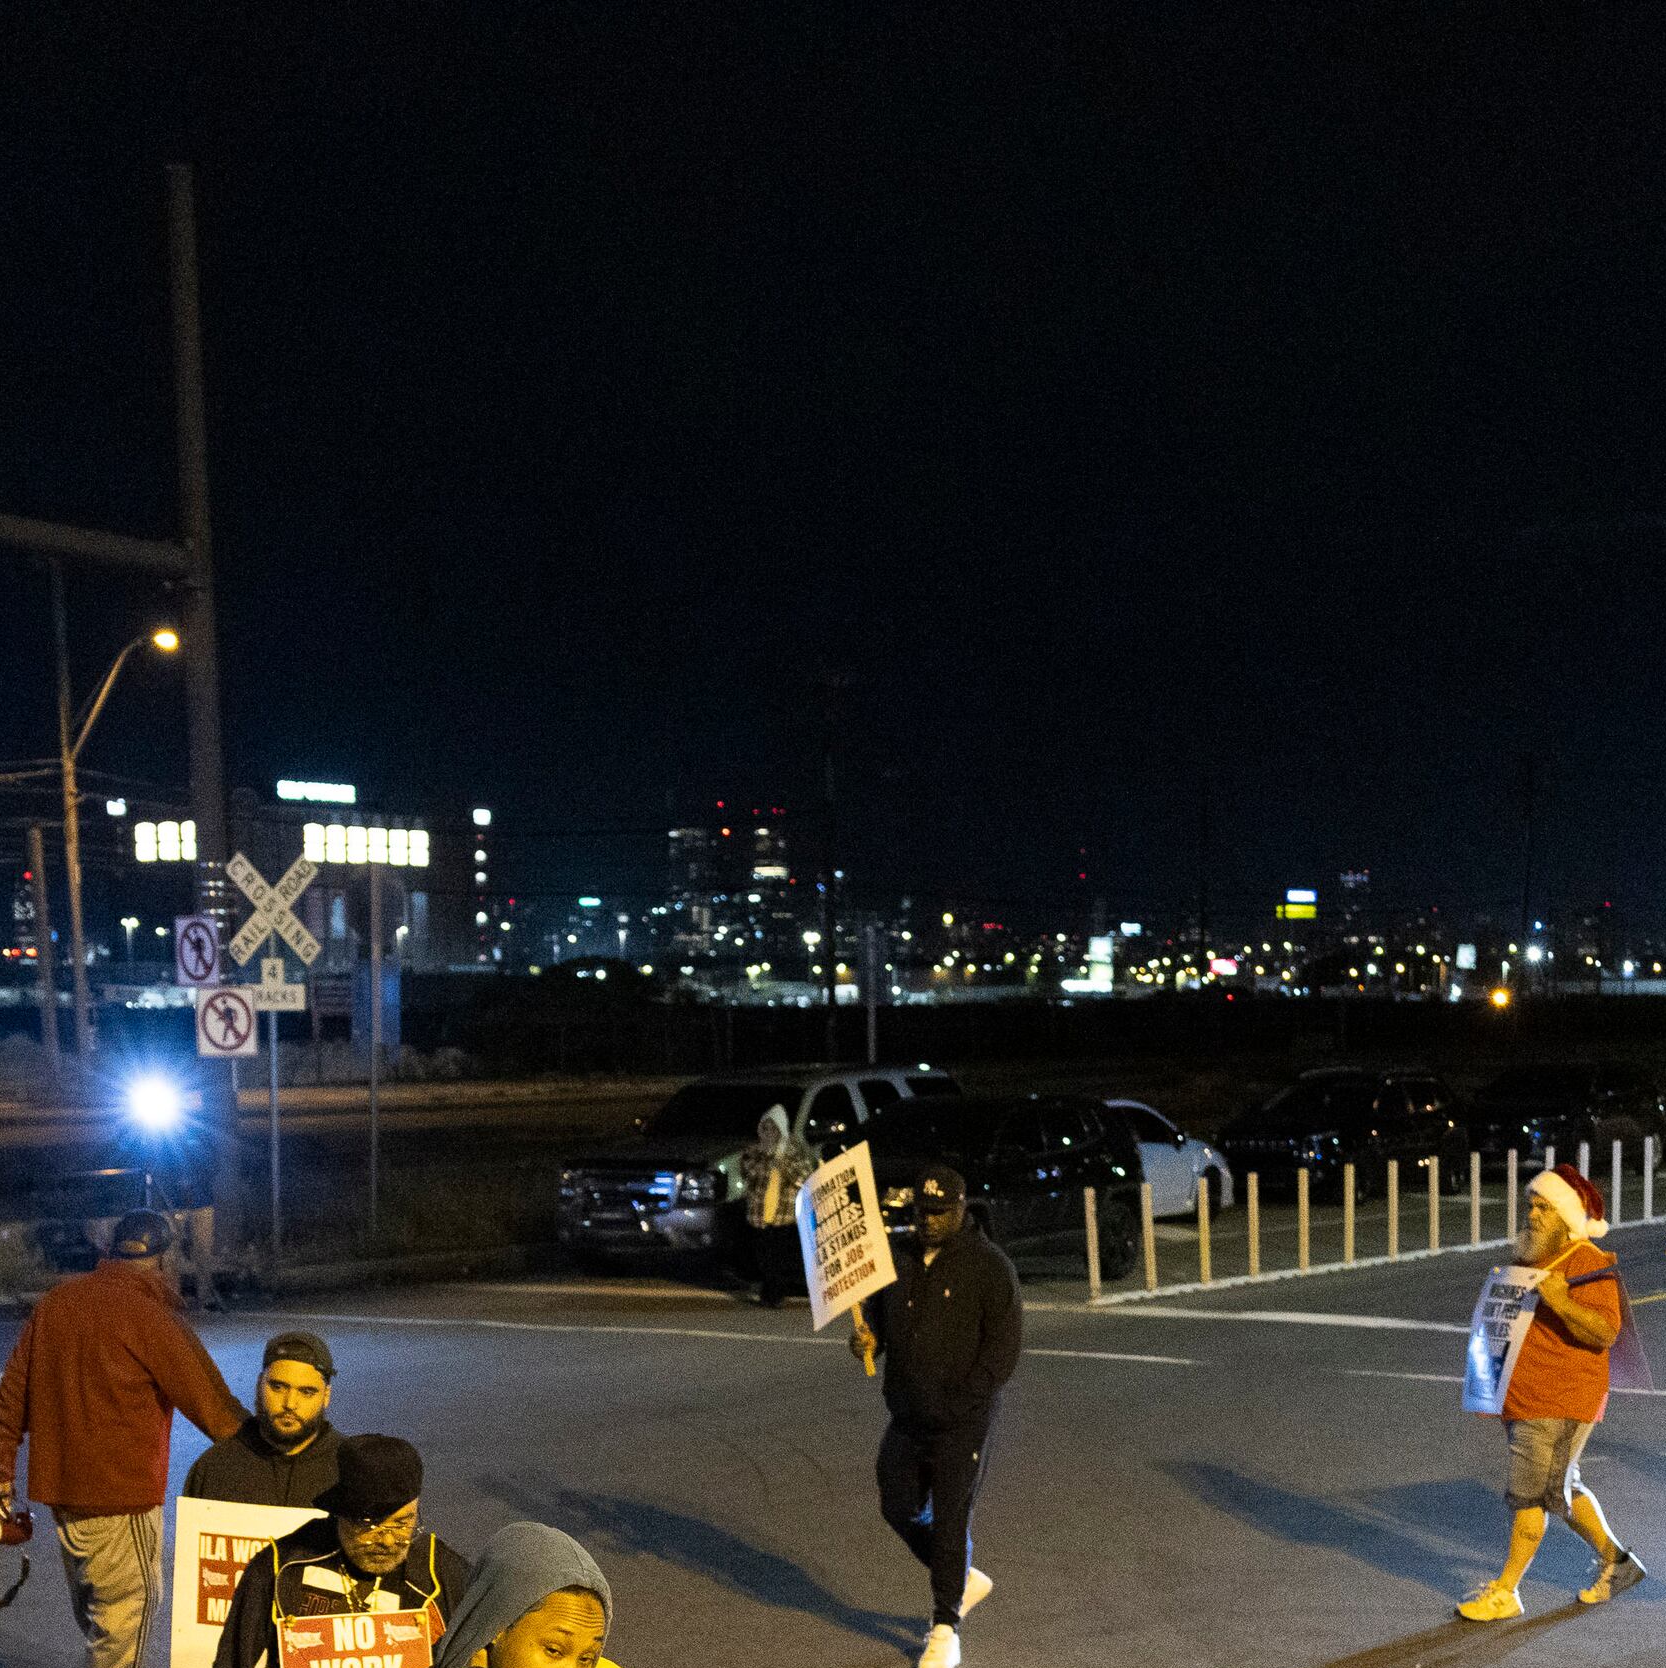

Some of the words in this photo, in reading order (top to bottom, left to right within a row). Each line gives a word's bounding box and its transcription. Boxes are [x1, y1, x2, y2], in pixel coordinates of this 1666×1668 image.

[255, 989, 298, 1003] RACKS
[199, 1535, 228, 1561] ILA
[232, 1538, 273, 1564] WO
[332, 1616, 375, 1652] NO
